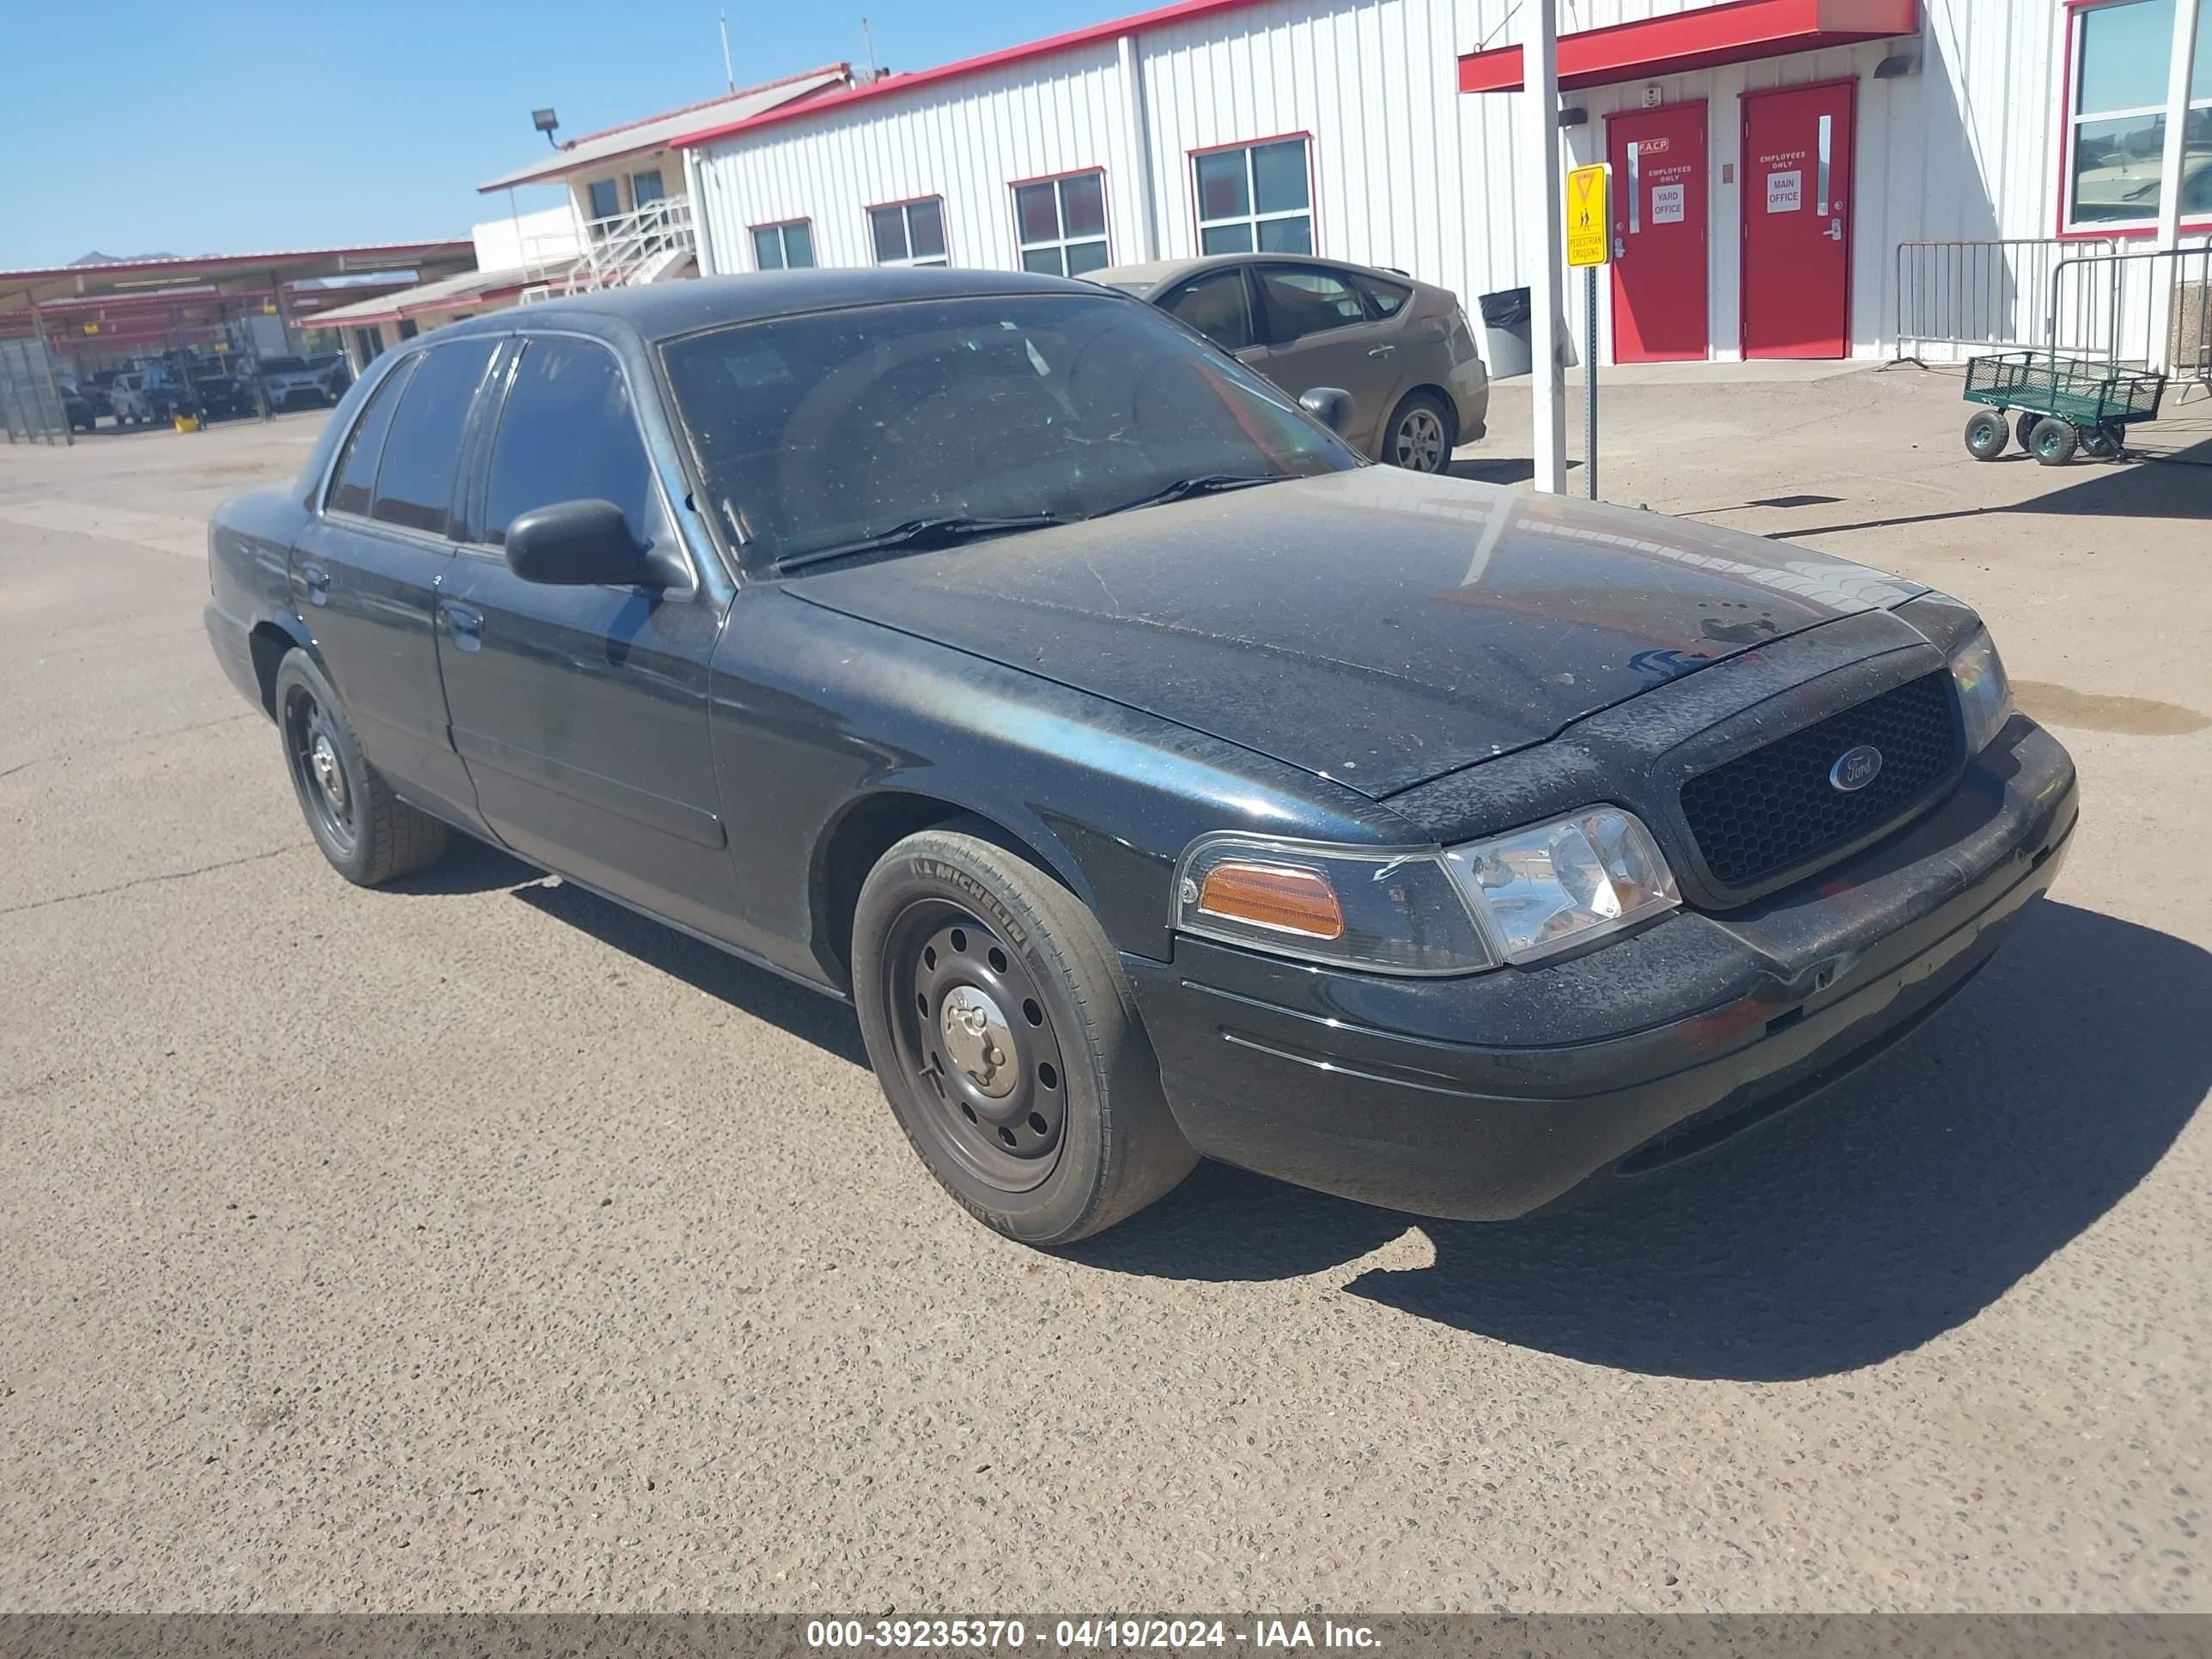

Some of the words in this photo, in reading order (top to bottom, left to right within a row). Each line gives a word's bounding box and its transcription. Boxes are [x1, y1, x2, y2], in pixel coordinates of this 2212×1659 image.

[1759, 150, 1806, 163] EMPLOYEES
[1649, 165, 1692, 177] EMPLOYEES
[1771, 161, 1793, 169] ONLY
[1660, 174, 1680, 183] ONLY
[1773, 179, 1795, 189] MAIN
[1657, 191, 1679, 201] YARD
[1769, 191, 1799, 204] OFFICE
[1654, 204, 1682, 215] OFFICE
[1569, 235, 1602, 248] PEDESTRIAN
[1572, 246, 1600, 258] CROSSING
[1847, 755, 1871, 782] Ford
[935, 862, 1028, 945] MICHELIN
